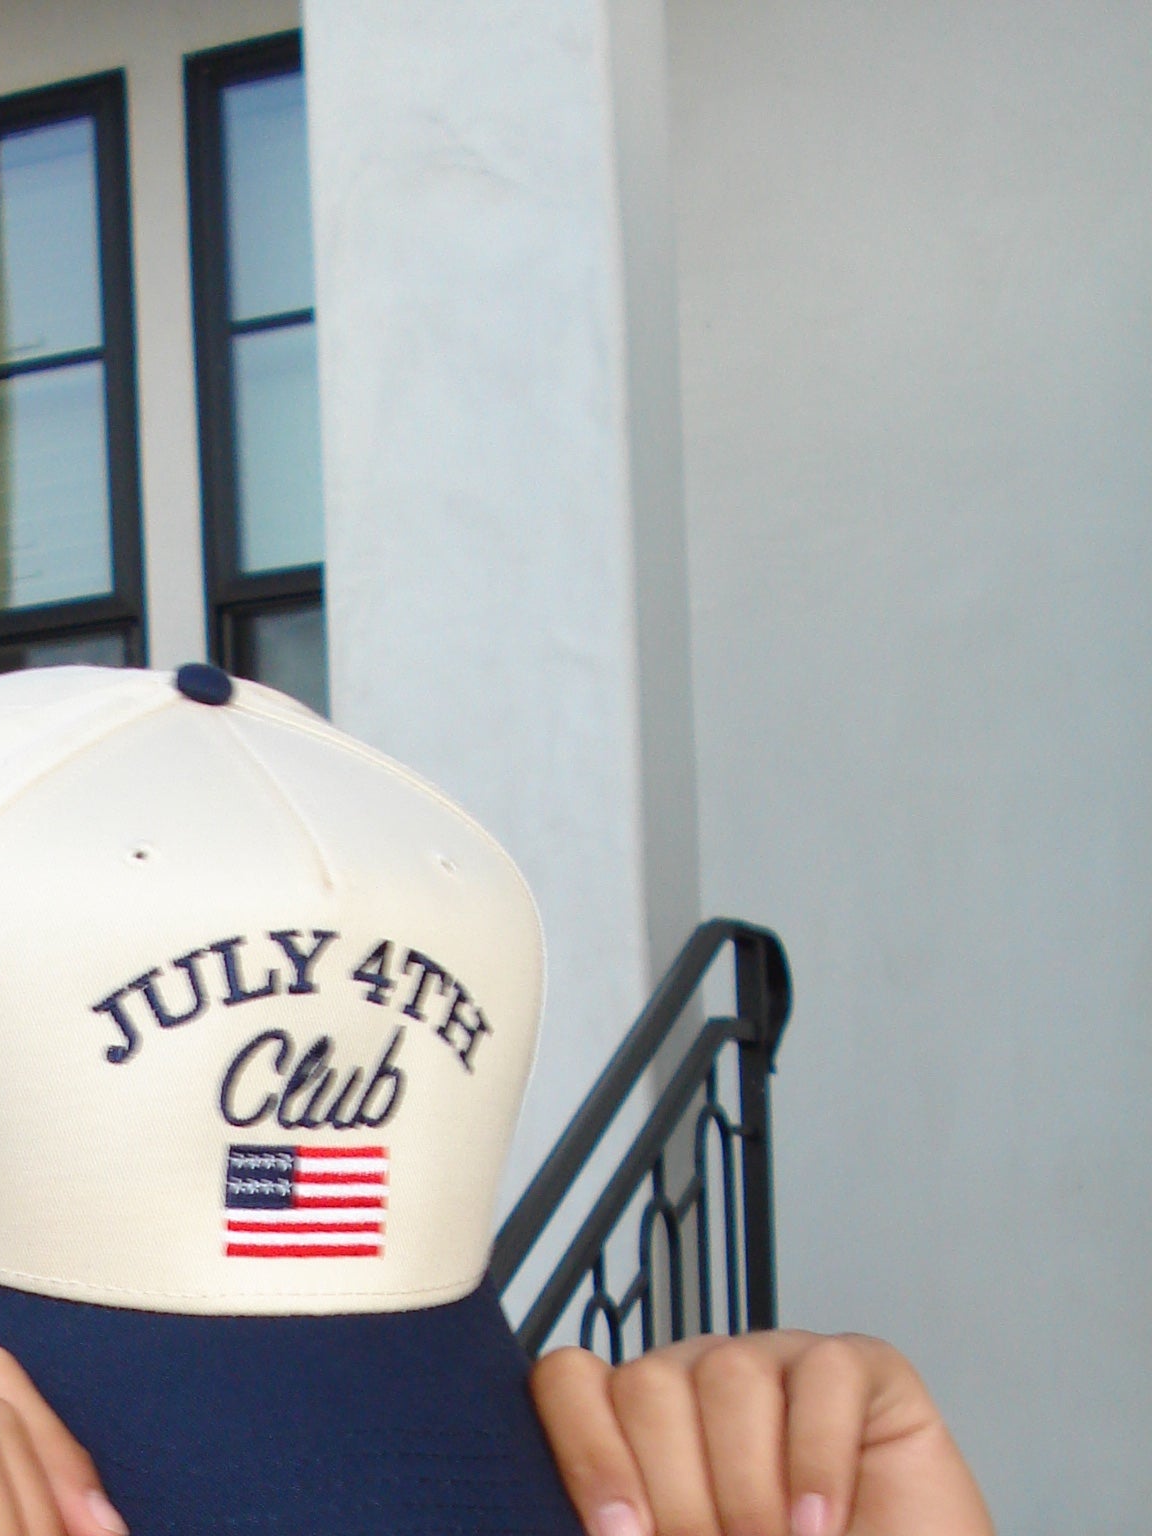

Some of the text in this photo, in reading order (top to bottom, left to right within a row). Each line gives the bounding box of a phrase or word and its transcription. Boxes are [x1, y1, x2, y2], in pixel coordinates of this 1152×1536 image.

[92, 929, 493, 1074] JULY 4TH
[220, 1025, 406, 1130] Club
